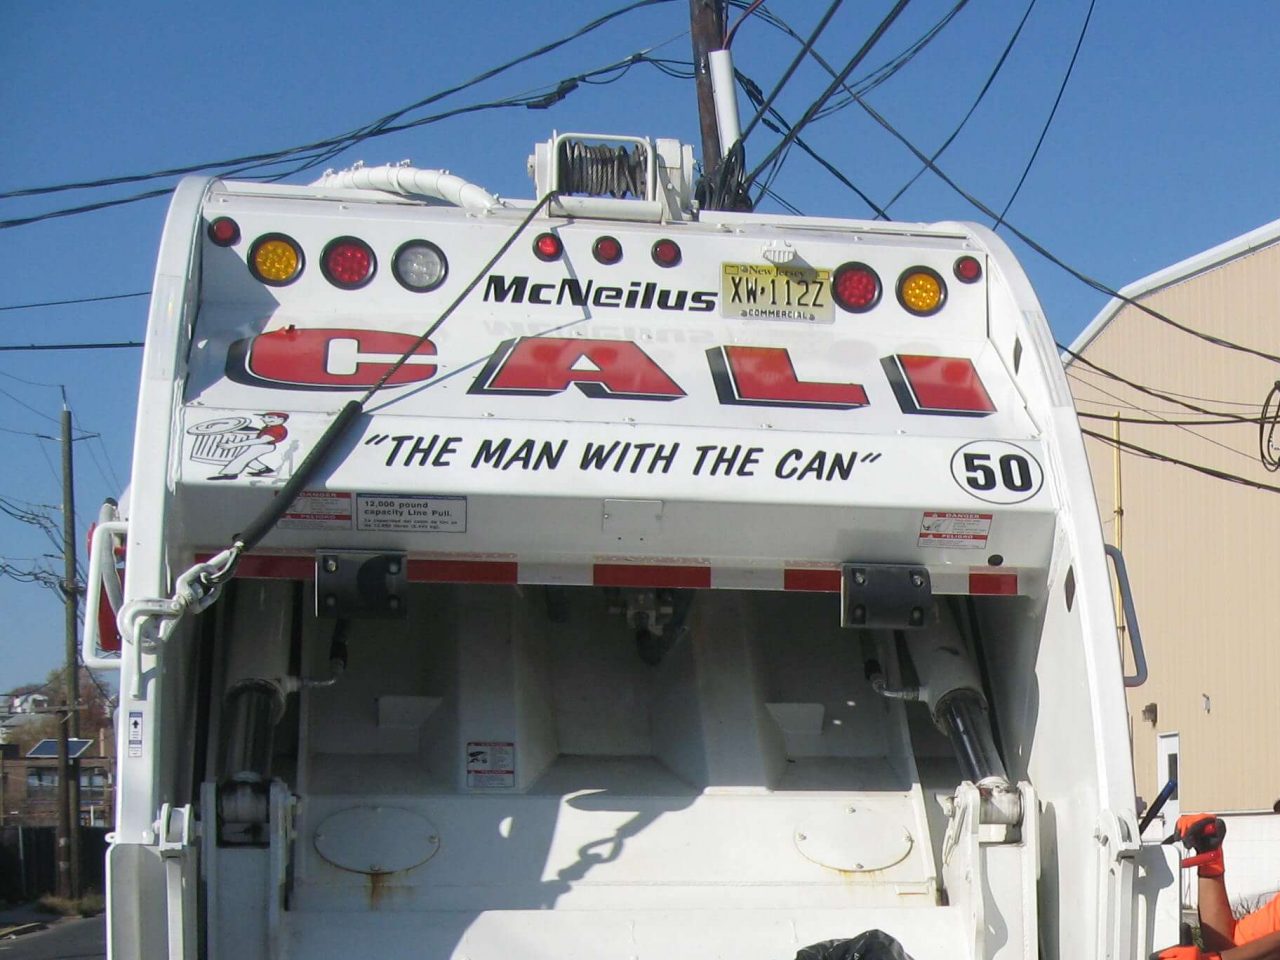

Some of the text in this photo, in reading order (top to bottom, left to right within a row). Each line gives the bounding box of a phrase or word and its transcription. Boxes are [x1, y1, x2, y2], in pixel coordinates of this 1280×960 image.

[748, 265, 773, 276] New
[482, 274, 719, 313] McNeilus
[748, 308, 808, 321] COMMERCIAL
[224, 327, 999, 417] CALI
[471, 437, 568, 471] MAN
[579, 440, 680, 475] WITH
[694, 444, 764, 477] THE
[963, 452, 1033, 493] 50
[363, 508, 404, 517] capacity
[398, 501, 429, 510] pound
